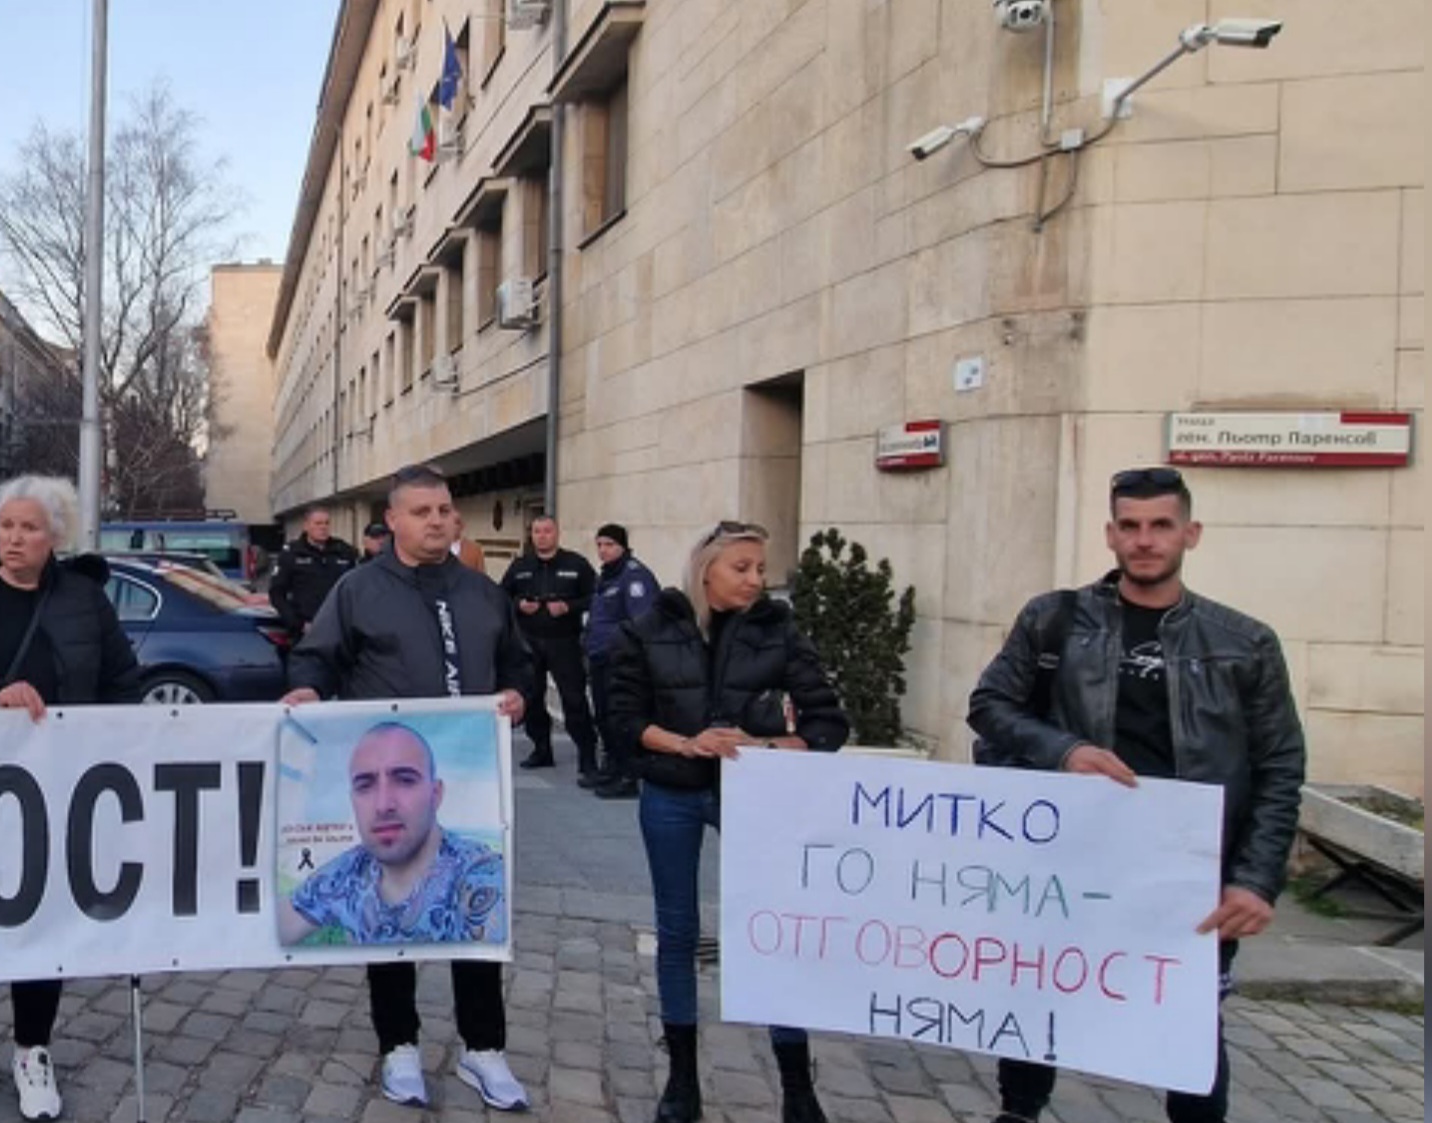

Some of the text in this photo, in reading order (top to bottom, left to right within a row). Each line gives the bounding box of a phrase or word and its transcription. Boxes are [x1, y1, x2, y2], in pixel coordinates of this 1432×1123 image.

[1288, 430, 1377, 447] Паренсов
[851, 781, 1061, 844] МИТКО
[800, 843, 875, 896] ГО
[746, 909, 1183, 1005] ОТГОВОРНОСТ
[869, 991, 1058, 1062] НЯМА!
